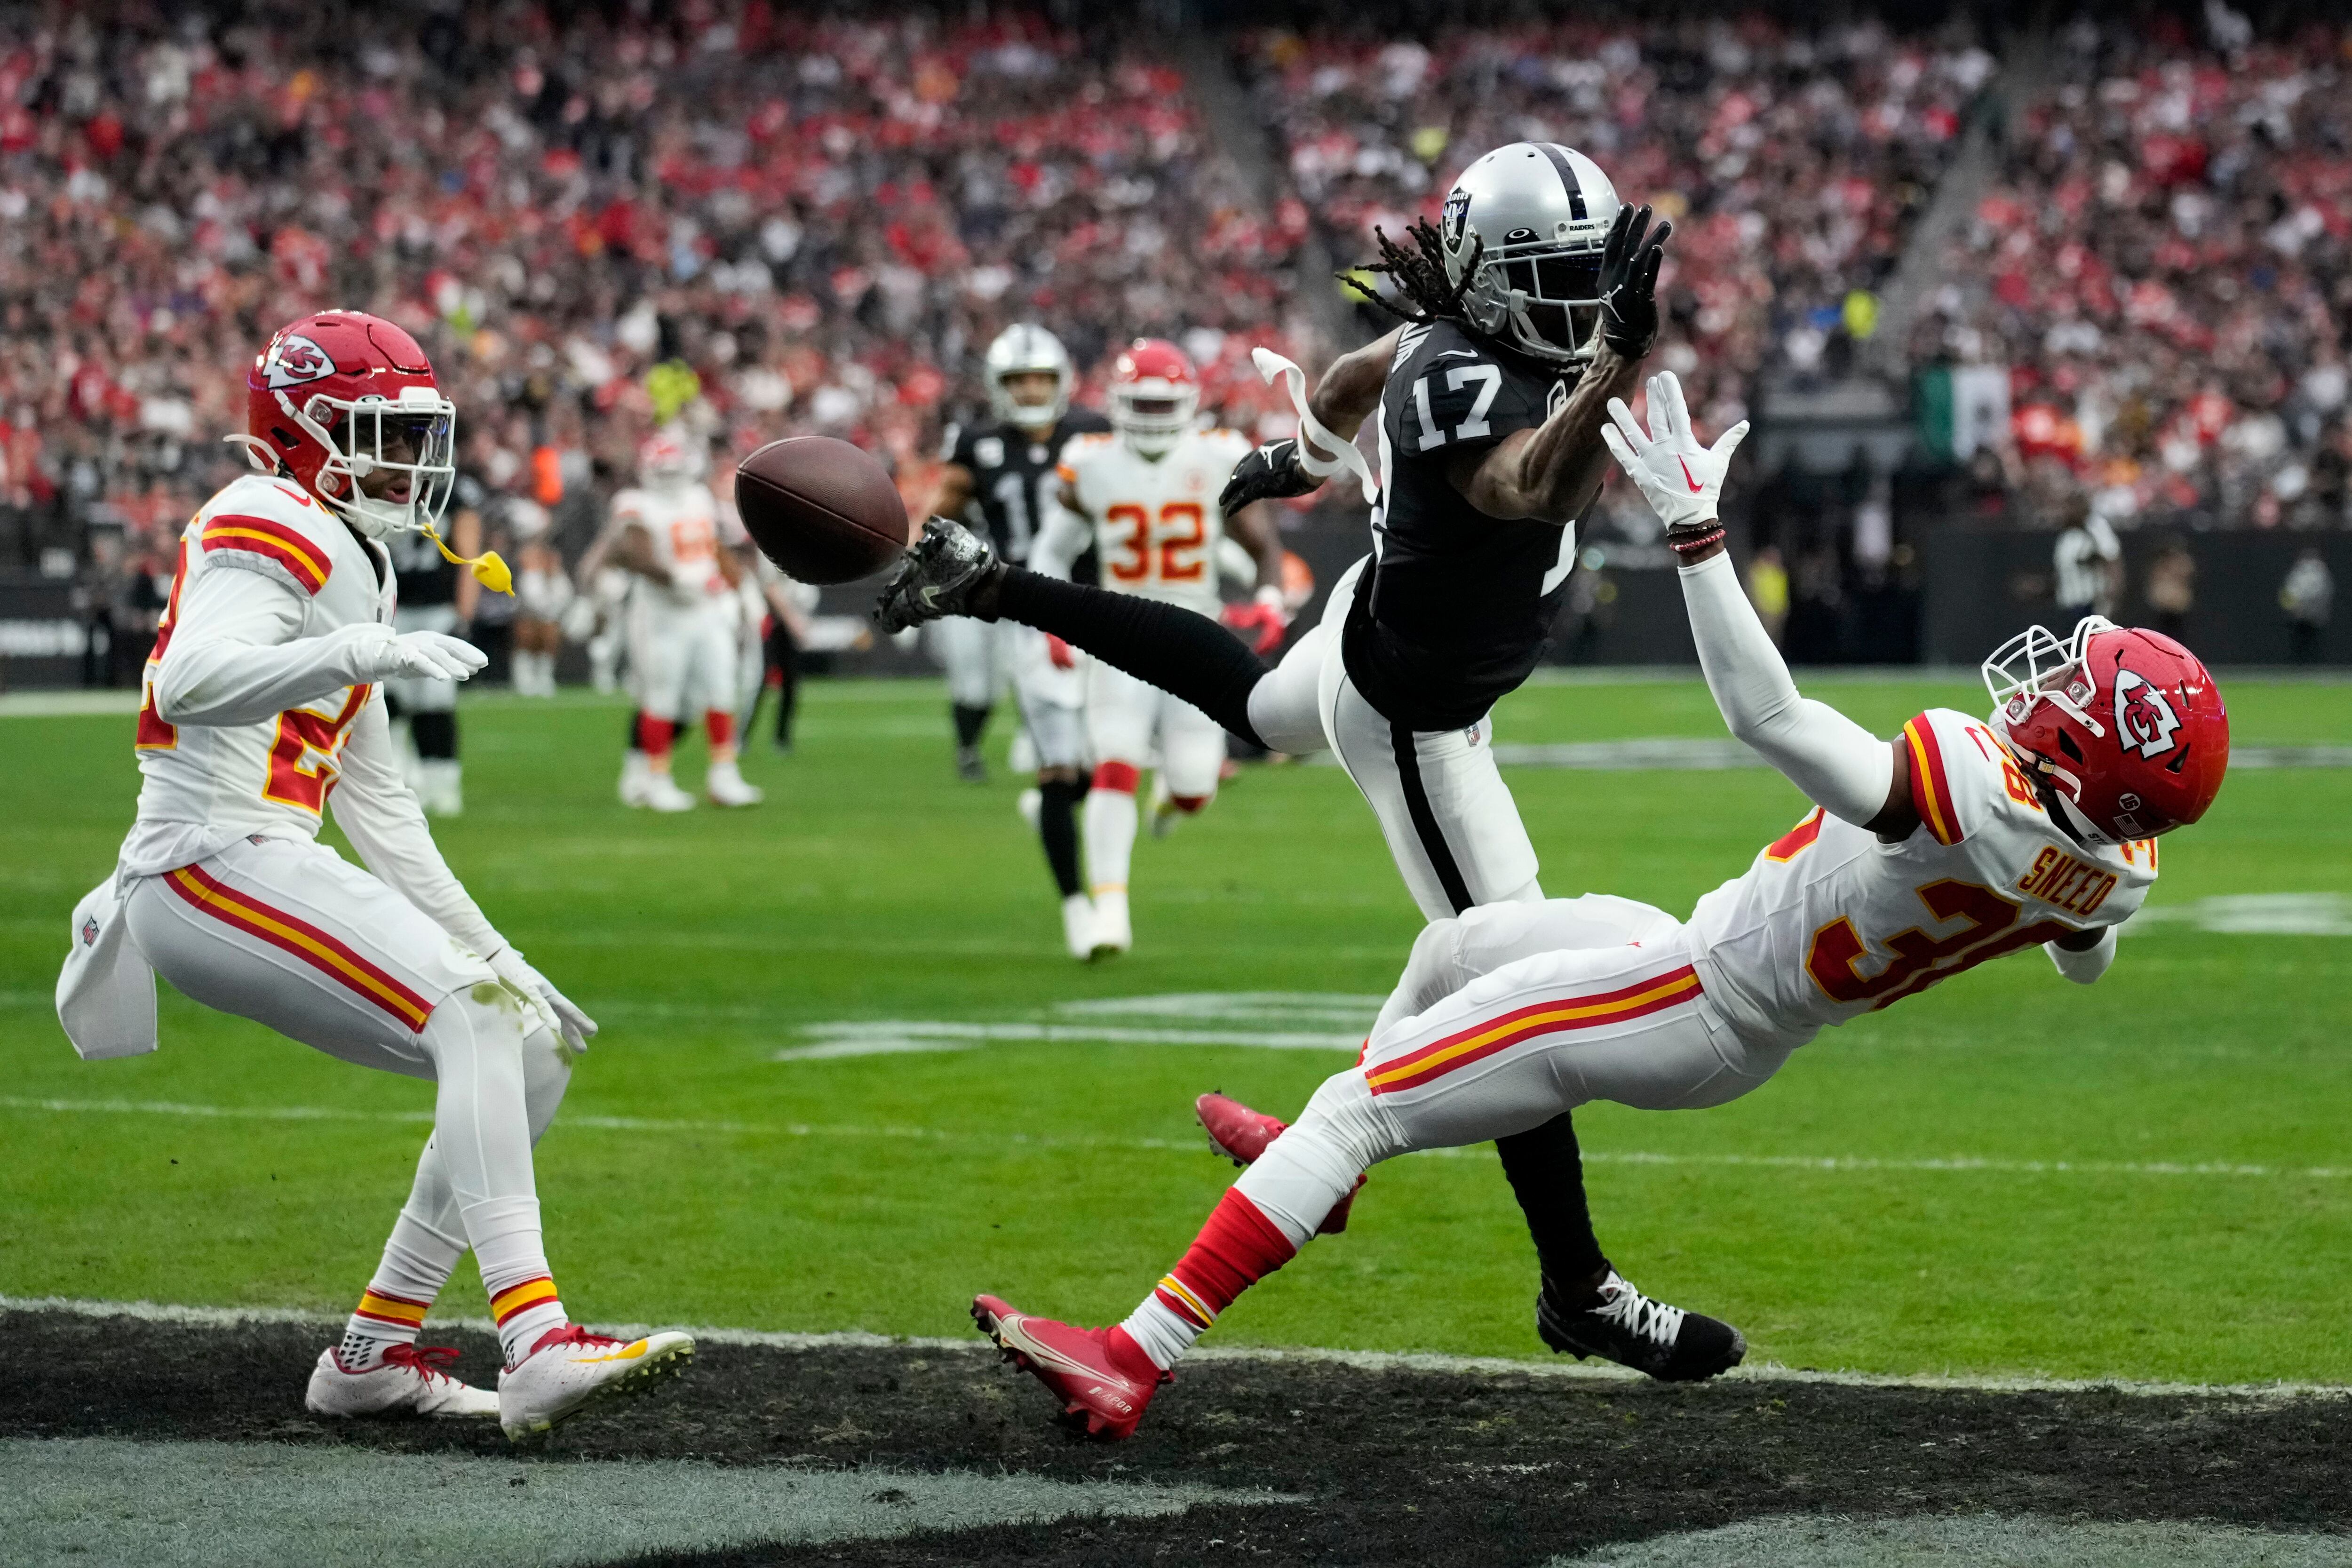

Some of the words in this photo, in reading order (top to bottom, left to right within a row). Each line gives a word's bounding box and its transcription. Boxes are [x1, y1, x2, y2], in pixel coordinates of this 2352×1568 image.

[1447, 192, 1469, 202] AIDERS
[275, 345, 325, 379] KC
[1413, 364, 1502, 452] 17
[1107, 501, 1205, 582] 32
[2122, 681, 2163, 746] KC
[2120, 795, 2139, 810] 16
[2017, 845, 2119, 916] SNEED
